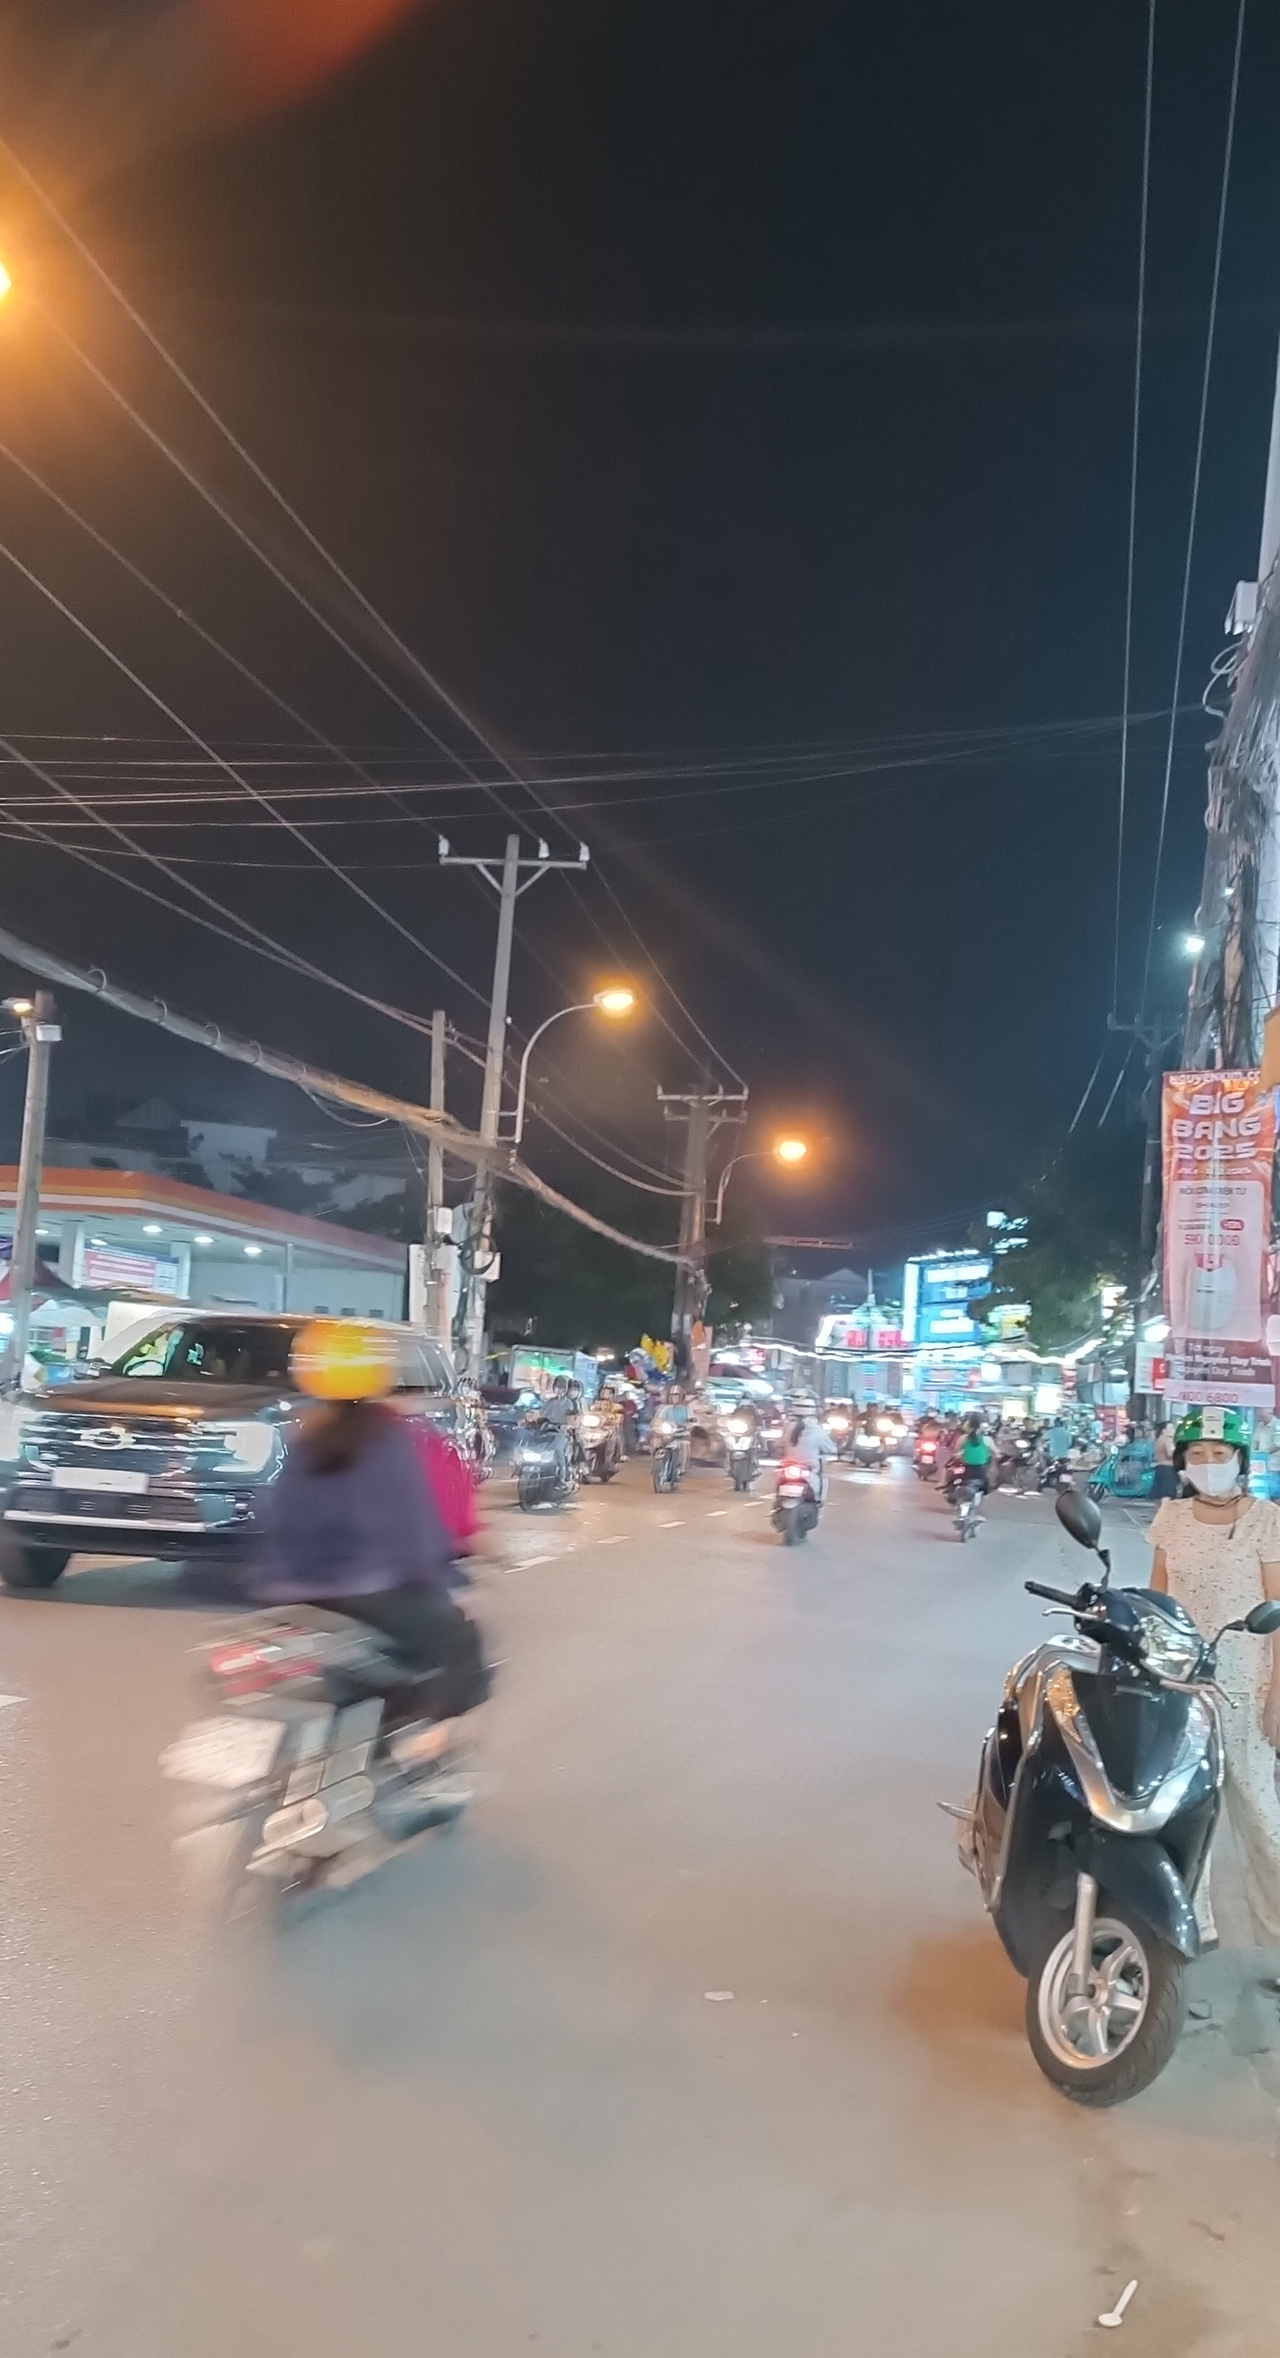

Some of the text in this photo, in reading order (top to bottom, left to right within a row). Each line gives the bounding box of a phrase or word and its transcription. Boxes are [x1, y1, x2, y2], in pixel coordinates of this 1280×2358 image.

[1190, 1092, 1244, 1114] BIG
[1172, 1117, 1261, 1139] BANG
[1174, 1141, 1258, 1161] 2025
